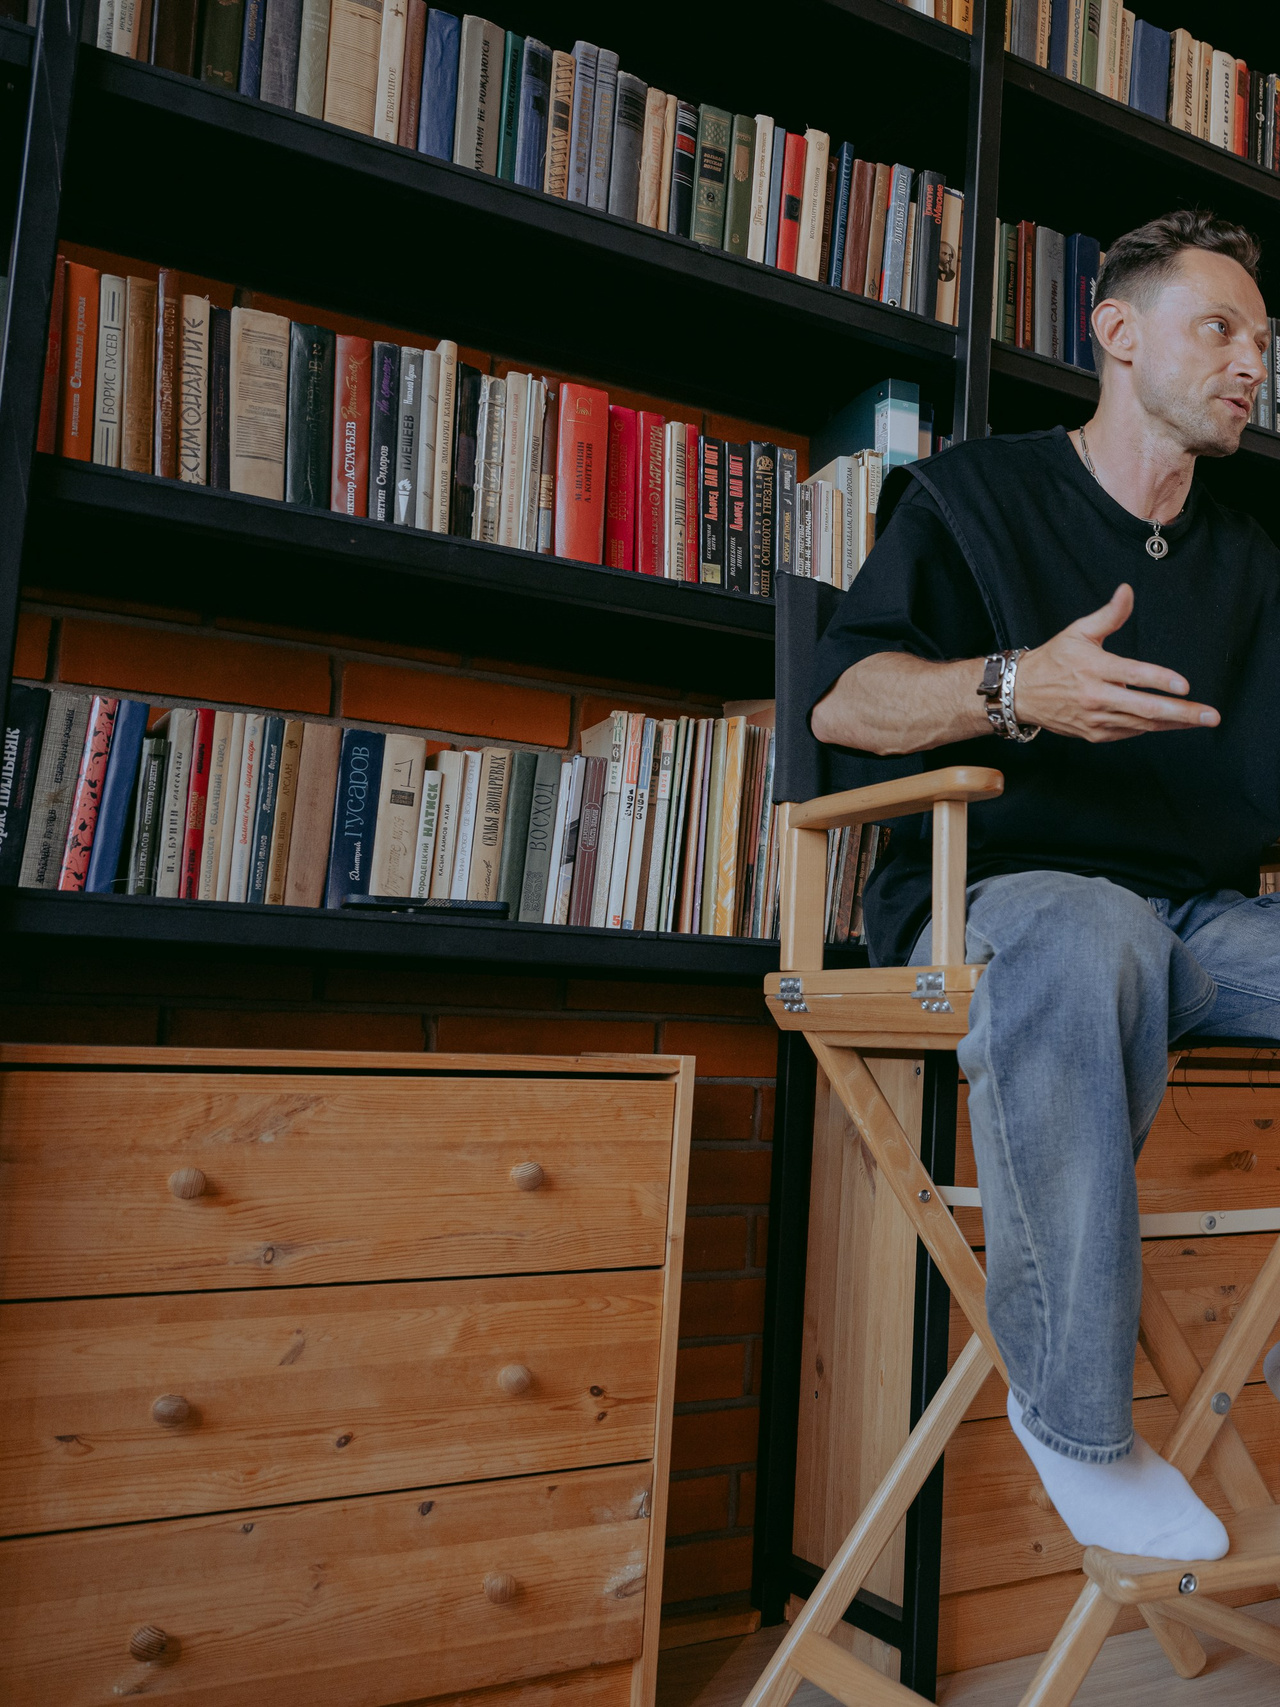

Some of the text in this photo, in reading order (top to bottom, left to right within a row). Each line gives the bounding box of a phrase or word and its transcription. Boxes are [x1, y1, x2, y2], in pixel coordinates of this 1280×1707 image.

[1073, 8, 1081, 57] НИКИФОРОВ
[386, 67, 397, 123] ИЗБРАННОЕ
[477, 39, 490, 122] НЕ РОЖДАЮТСЯ
[509, 48, 519, 98] СТАЛИНГРАДА
[1184, 72, 1193, 116] СУРОВЫХ
[506, 100, 515, 130] ОКОПАХ
[808, 166, 820, 240] КОНСТАНТИН СИМОНОВ
[836, 152, 852, 259] водного транспорта СССР
[894, 174, 908, 245] ЭЛИЗАБЕТ ЛОРД
[922, 184, 934, 216] Трилогия
[932, 183, 945, 219] Максиме
[164, 304, 175, 338] ЧЕСТЬ!
[102, 333, 118, 415] БОРИС ГУСЕВ
[162, 353, 174, 394] СВОБОДУ
[344, 421, 357, 480] АСТАФЬЕВ
[402, 415, 414, 470] ПЛЕЩЕЕВ
[438, 372, 454, 534] БОРИС ГОРБАТОВ ЭММАНУИЛ КАЗАКЕВИЧ
[510, 420, 518, 456] ЯРОСЛАВСКОЙ
[649, 426, 663, 492] МАРИАННА
[704, 443, 718, 466] ВОГТ
[376, 444, 389, 486] Сидоров
[576, 442, 584, 490] ШАГИНЯН
[585, 442, 593, 490] КОПТЕЛОВ
[608, 432, 620, 520] Кто слышал
[618, 444, 628, 521] крик аиста
[676, 442, 686, 487] НАКАНУНЕ
[704, 470, 718, 488] ВАН
[729, 454, 743, 476] ВОГТ
[675, 498, 686, 526] РУДИН
[729, 480, 744, 498] ВАН
[754, 474, 762, 534] БРЯНЦЕВ
[760, 476, 773, 598] ОНЕЦ ОСИНОГО ГНЕЗДА
[0, 727, 20, 807] ПИЛЬНЯК
[172, 751, 182, 800] РАССКАЗЫ
[196, 743, 205, 774] МЕМУАРЫ
[209, 774, 222, 826] ОБЛАЧНЫЙ
[216, 737, 227, 768] ГОРОД
[282, 763, 292, 797] АРСЛАН
[468, 759, 476, 784] СОЛНЦЕ
[663, 756, 671, 766] 8
[144, 760, 159, 825] СТИХОТВОРЕНИЯ
[189, 790, 199, 829] РАДОСТНАЯ
[422, 783, 438, 838] НАТИСК
[481, 754, 506, 846] СЕМЬЯ ЗВОНАРЕВЫХ
[636, 792, 644, 820] 1973
[440, 826, 448, 852] КАИМОВ
[530, 783, 558, 851] ВОСХОД
[588, 828, 597, 846] ВЛАСТЬ
[254, 834, 268, 890] НИКОЛАЙ ИВАНОВ
[348, 841, 362, 880] Дмитрий
[460, 832, 468, 856] ДРОБОТ
[458, 857, 466, 882] ГАЛИНА
[612, 915, 620, 926] 5
